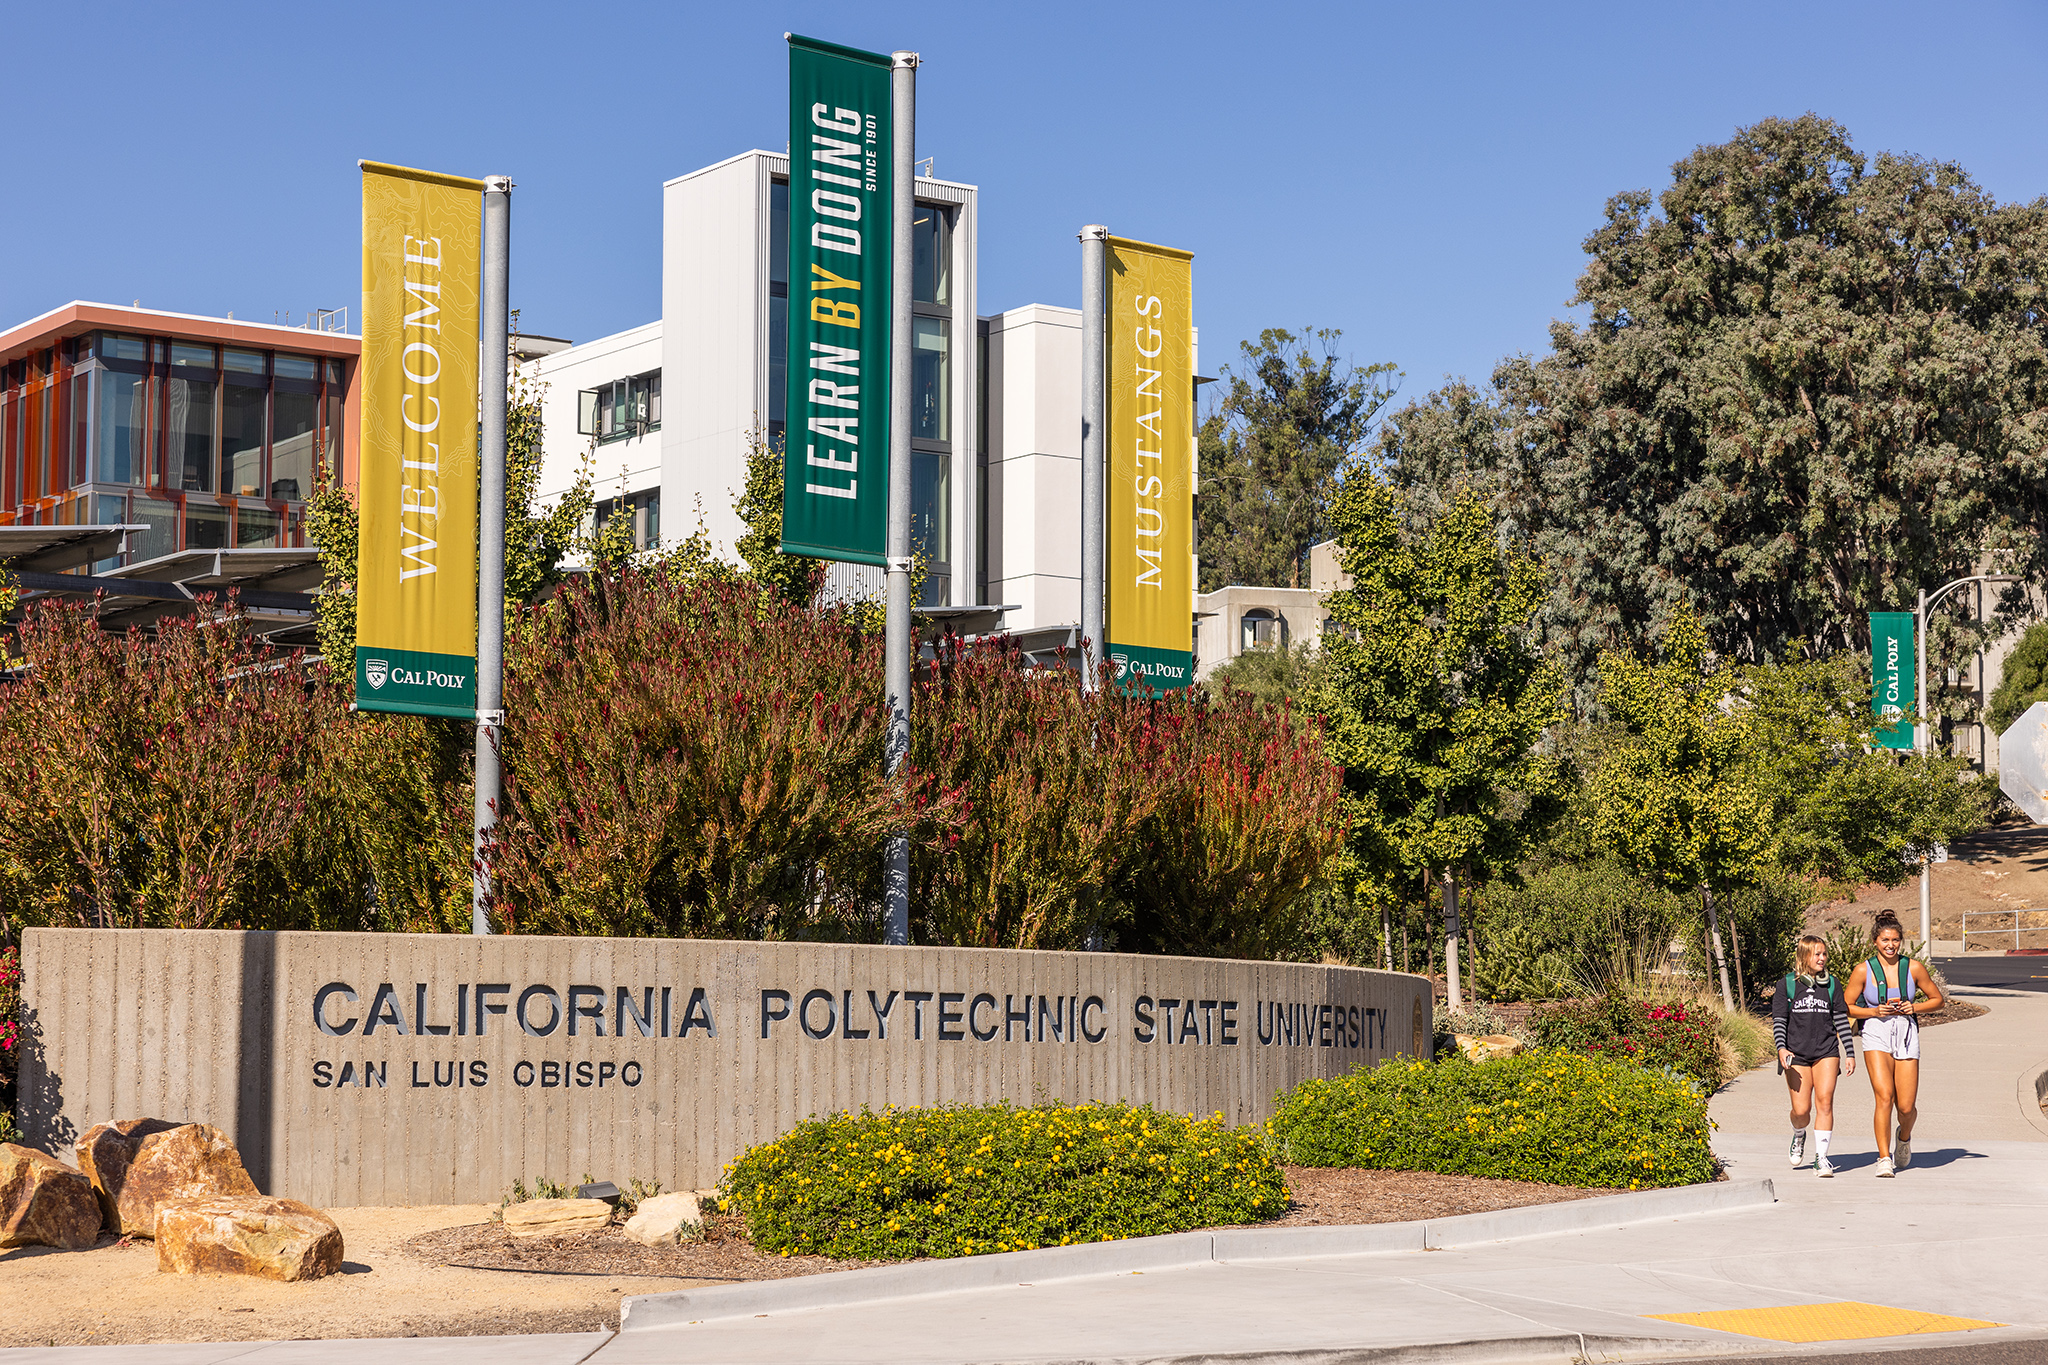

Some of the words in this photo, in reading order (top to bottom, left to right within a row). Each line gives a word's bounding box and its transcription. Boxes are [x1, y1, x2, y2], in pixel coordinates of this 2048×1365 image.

[865, 113, 877, 145] 1901
[811, 101, 862, 256] DOING
[865, 150, 877, 192] SINCE
[811, 262, 861, 329] BY
[400, 233, 443, 585] WELCOME
[806, 341, 860, 500] LEARN
[1135, 294, 1162, 591] MUSTANGS
[1129, 660, 1155, 677] CAL
[1156, 662, 1185, 679] POLY
[1887, 636, 1899, 671] POLY
[391, 667, 425, 685] CAL
[426, 670, 466, 689] POLY
[1887, 672, 1899, 702] CAL
[312, 982, 718, 1038] CALIFORNIA
[761, 988, 1109, 1045] POLYTECHNIC
[1133, 995, 1240, 1046] STATE
[1257, 1000, 1388, 1050] UNIVERSITY
[311, 1060, 388, 1088] SAN
[411, 1060, 490, 1088] LUIS
[513, 1060, 643, 1088] OBISPO
